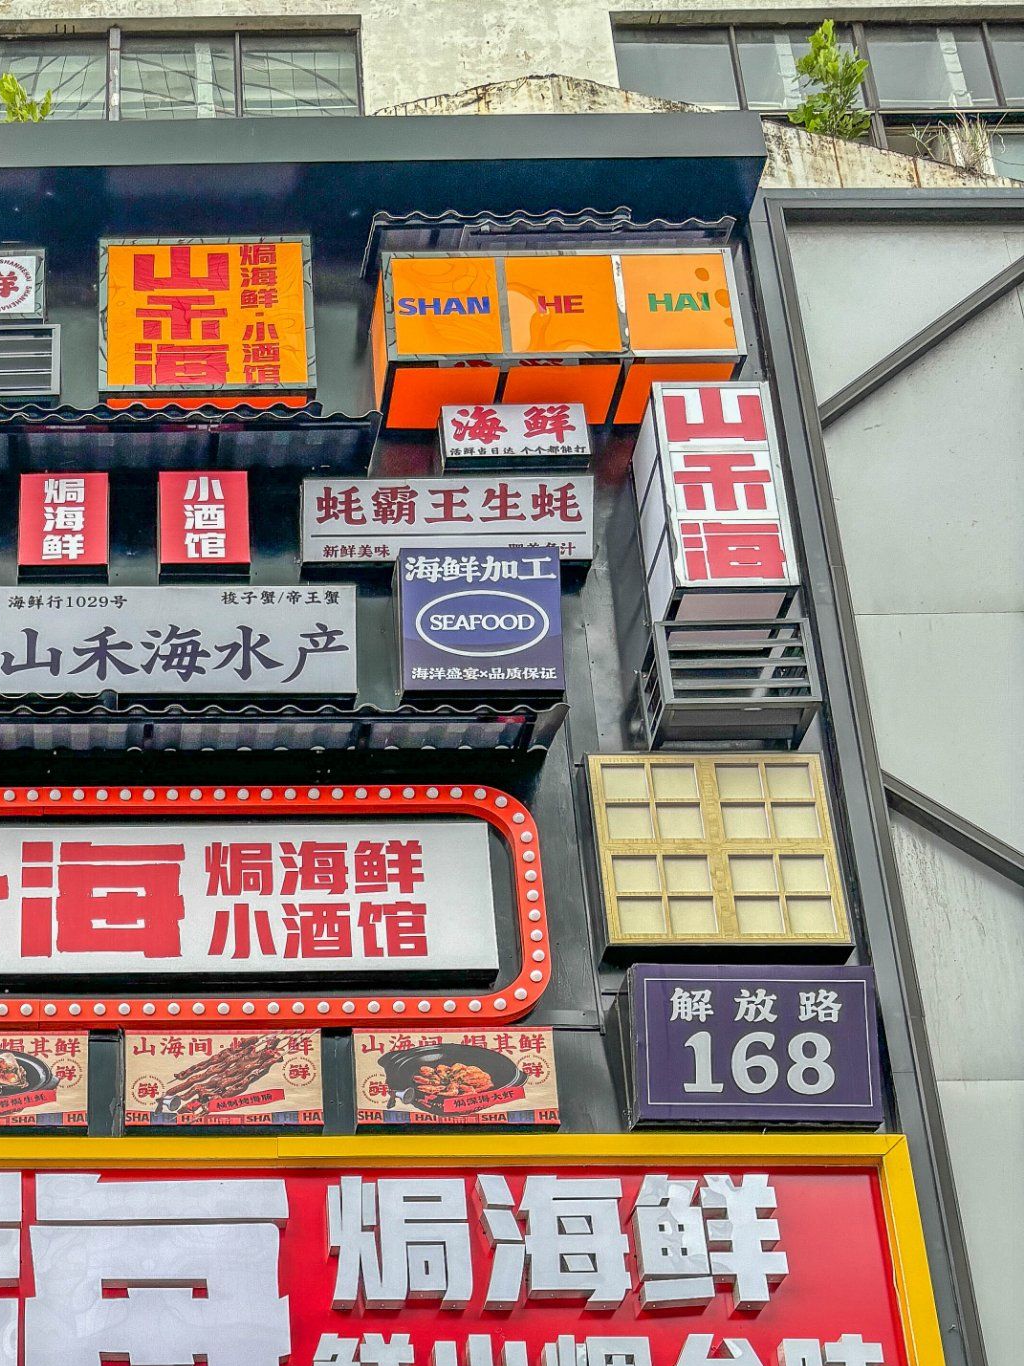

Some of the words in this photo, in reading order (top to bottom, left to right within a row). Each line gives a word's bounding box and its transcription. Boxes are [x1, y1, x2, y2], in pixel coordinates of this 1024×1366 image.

[398, 296, 490, 316] SHAN
[537, 295, 585, 314] HE
[648, 292, 710, 313] HAI
[451, 405, 576, 444] 海鲜
[41, 478, 84, 560] 焗海鲜
[184, 476, 226, 559] 小酒馆
[316, 482, 583, 525] 蚝霸王生蚝
[323, 544, 390, 558] 新鲜美味
[405, 556, 557, 583] 海鲜加工
[8, 595, 128, 609] 海鲜行1029号
[429, 614, 535, 631] SEAFOOD
[0, 622, 350, 684] 山禾海水产
[205, 839, 424, 898] 焗海鲜
[205, 899, 428, 960] 小酒馆
[670, 988, 842, 1023] 解放路
[684, 1031, 836, 1095] 168
[326, 1174, 788, 1310] 焗海鲜
